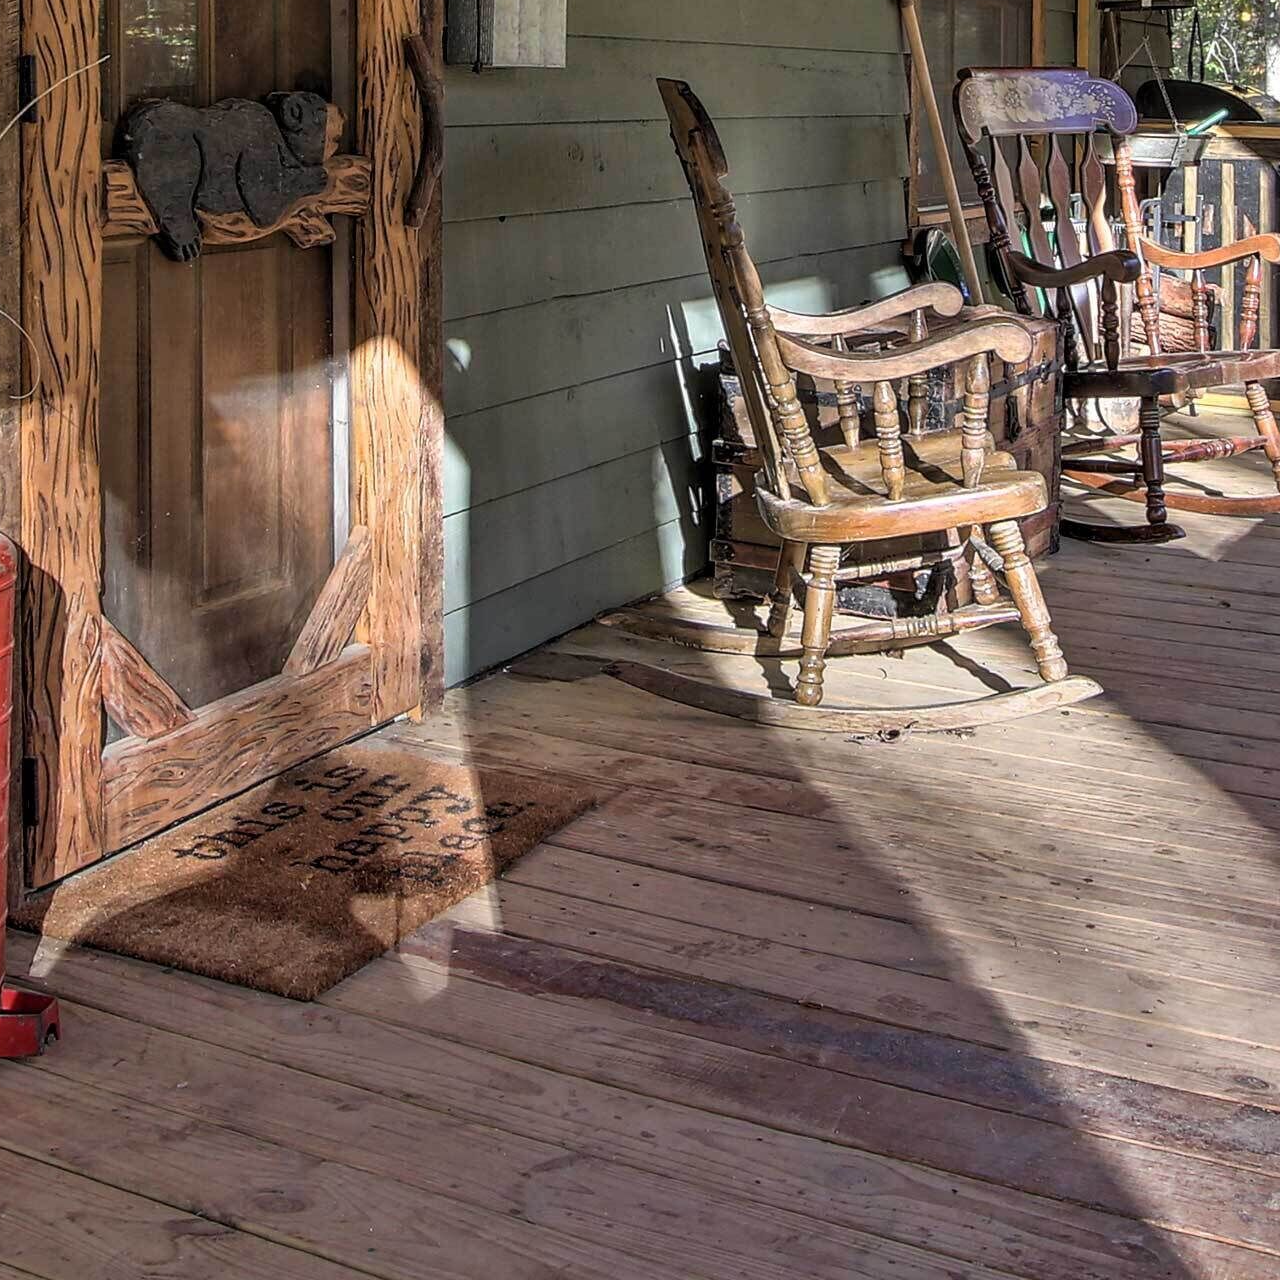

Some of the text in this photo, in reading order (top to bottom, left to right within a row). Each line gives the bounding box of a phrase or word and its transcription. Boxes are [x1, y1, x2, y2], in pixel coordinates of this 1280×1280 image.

[173, 766, 369, 860] this is
[290, 786, 474, 874] happy
[321, 774, 410, 822] our
